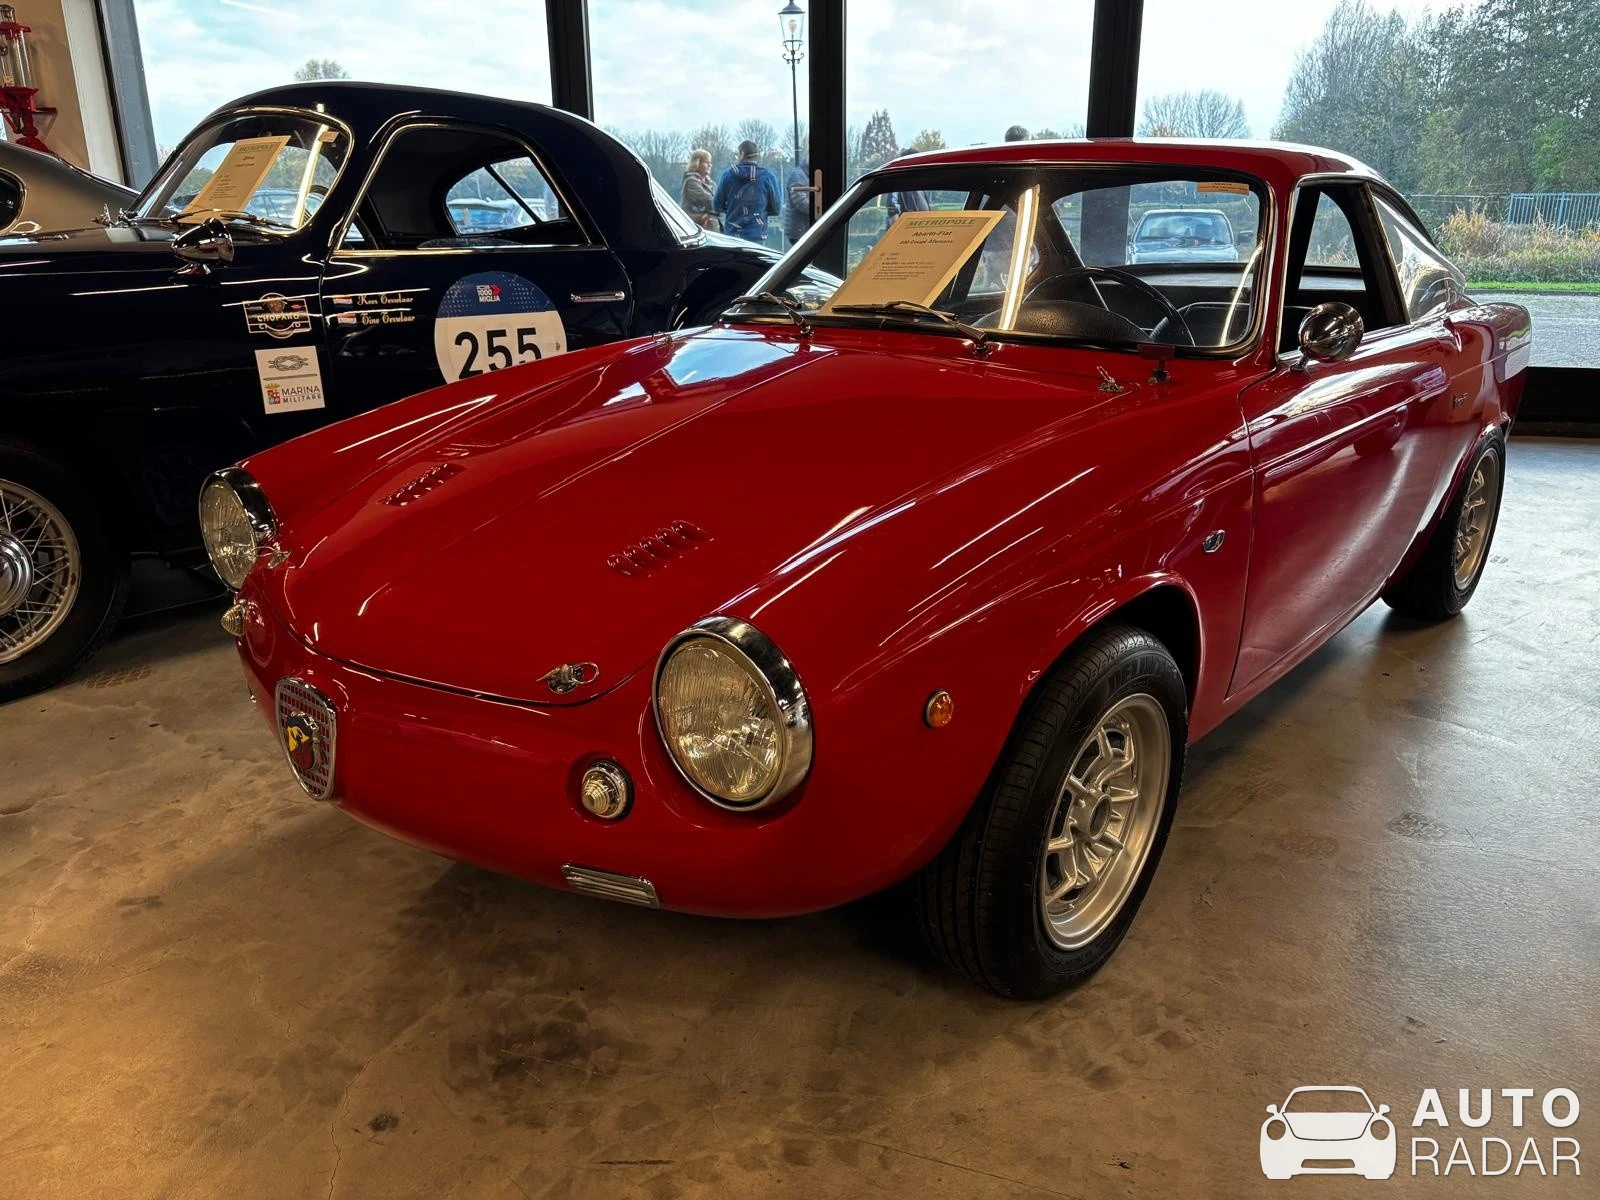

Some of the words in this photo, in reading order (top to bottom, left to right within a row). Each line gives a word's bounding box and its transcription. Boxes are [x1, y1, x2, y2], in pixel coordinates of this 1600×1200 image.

[455, 327, 542, 379] 255
[281, 385, 321, 396] MARINA
[283, 394, 321, 403] MILITARE
